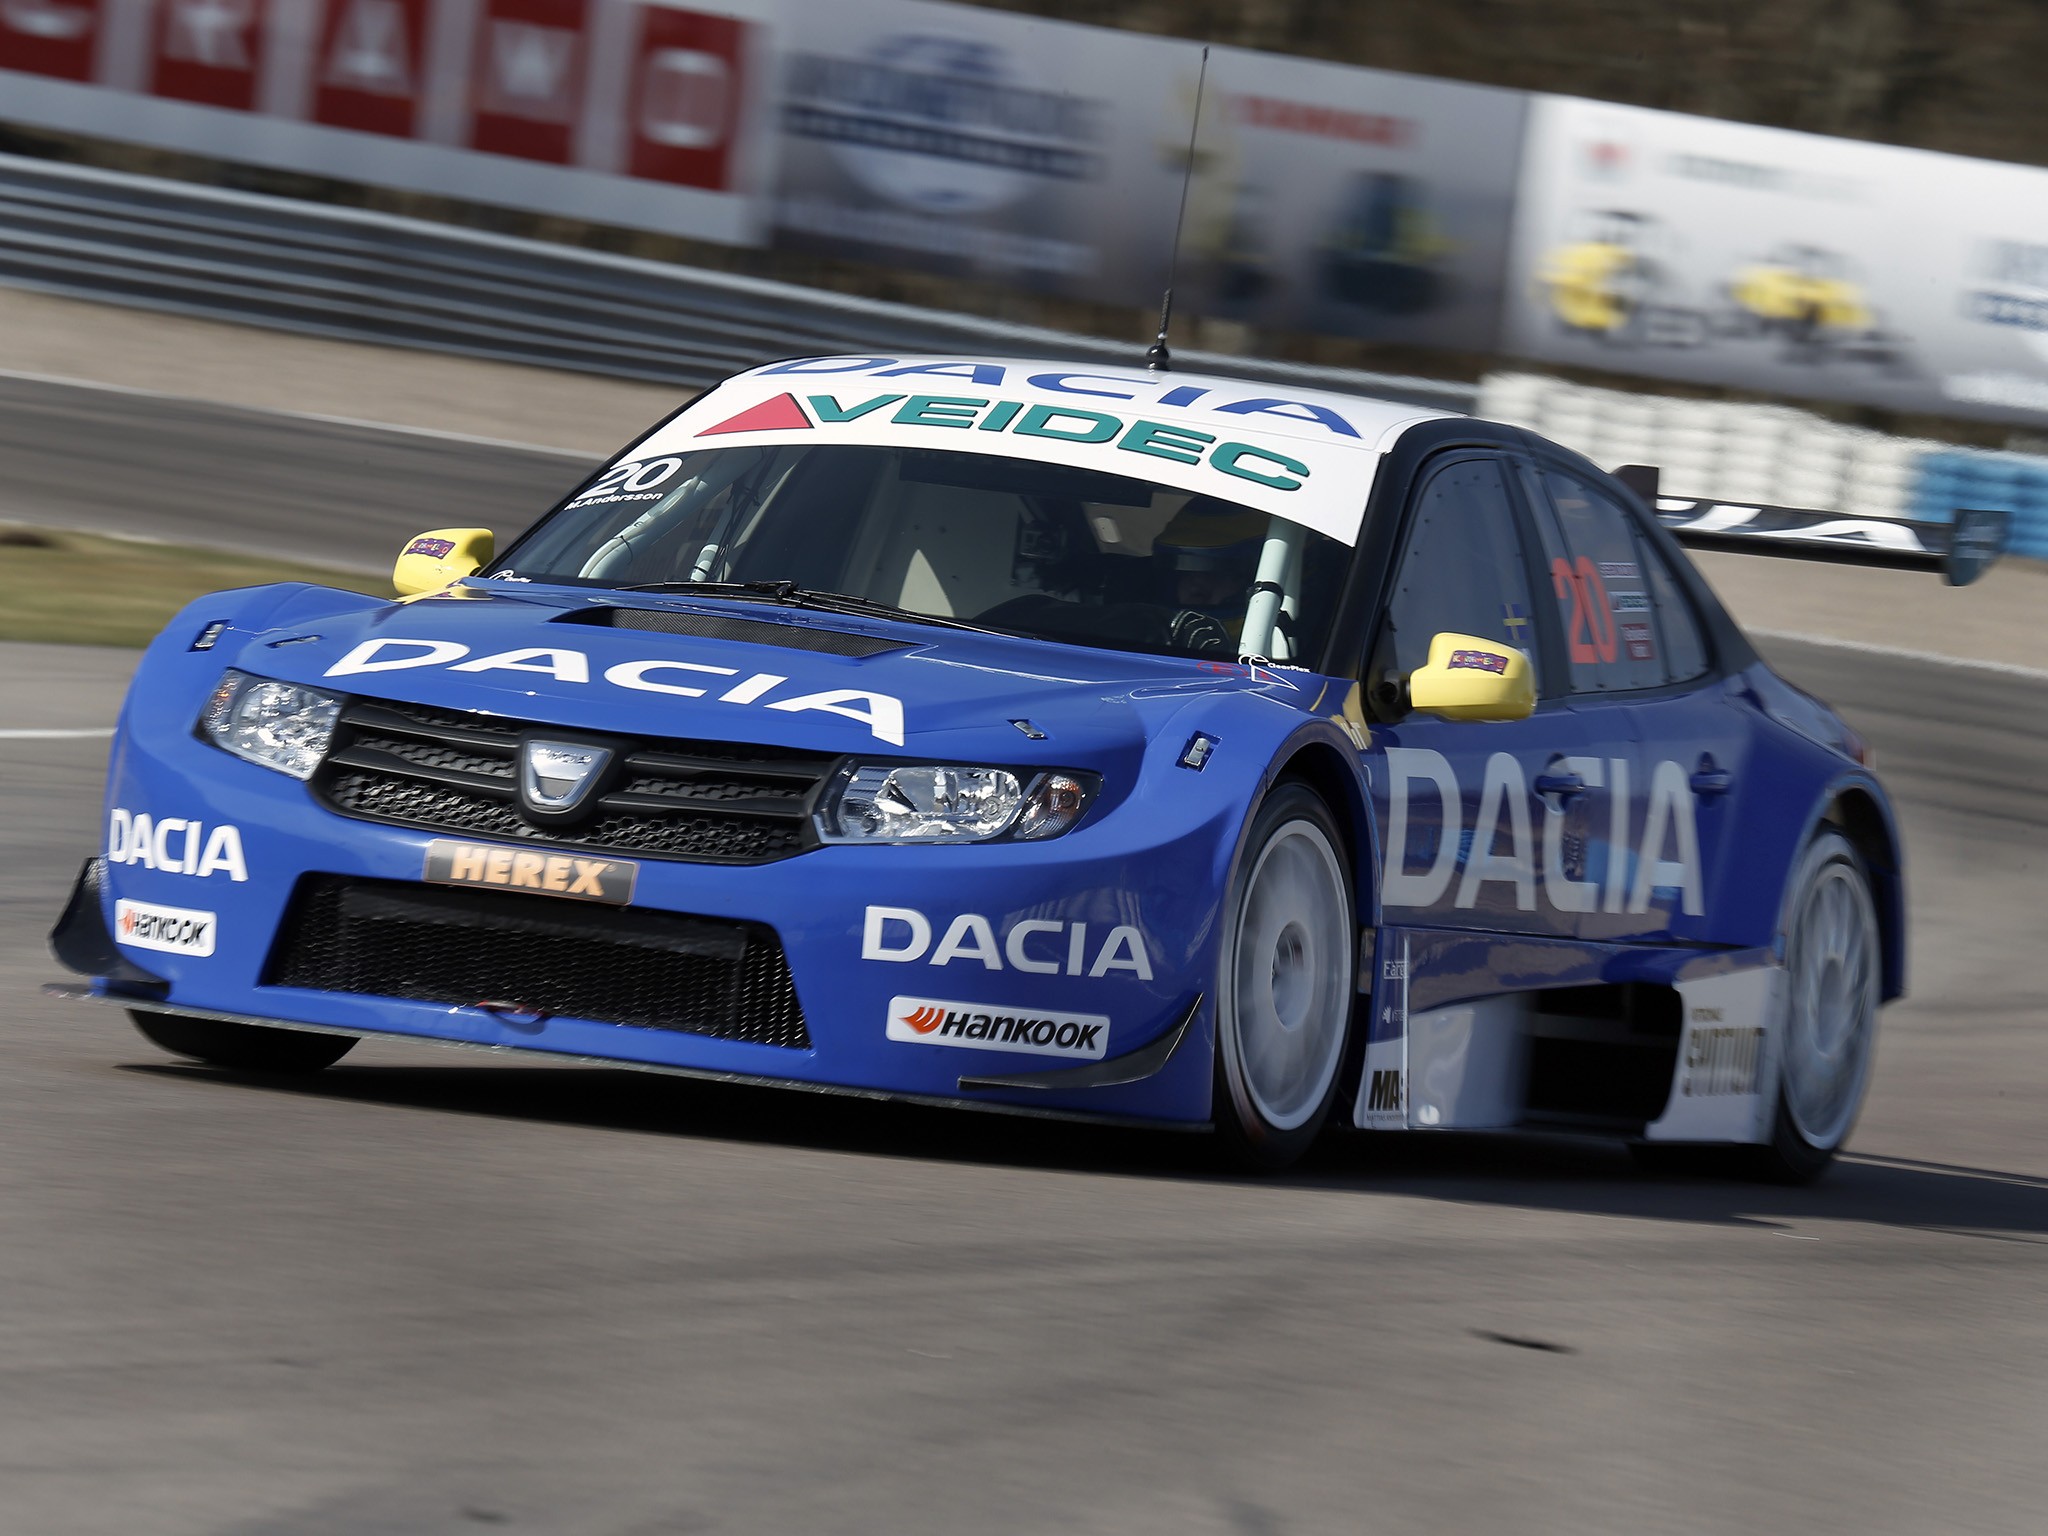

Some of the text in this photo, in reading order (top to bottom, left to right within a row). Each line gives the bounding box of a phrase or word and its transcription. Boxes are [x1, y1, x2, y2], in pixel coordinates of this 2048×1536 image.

[753, 357, 1363, 440] DACIA
[574, 457, 683, 501] 20
[807, 394, 1311, 492] VEIDEC
[1551, 555, 1618, 663] 20
[322, 638, 905, 747] DACIA
[108, 807, 249, 882] DACIA
[450, 846, 611, 897] HEREX
[1381, 746, 1705, 917] DACIA
[862, 904, 1154, 981] DACIA
